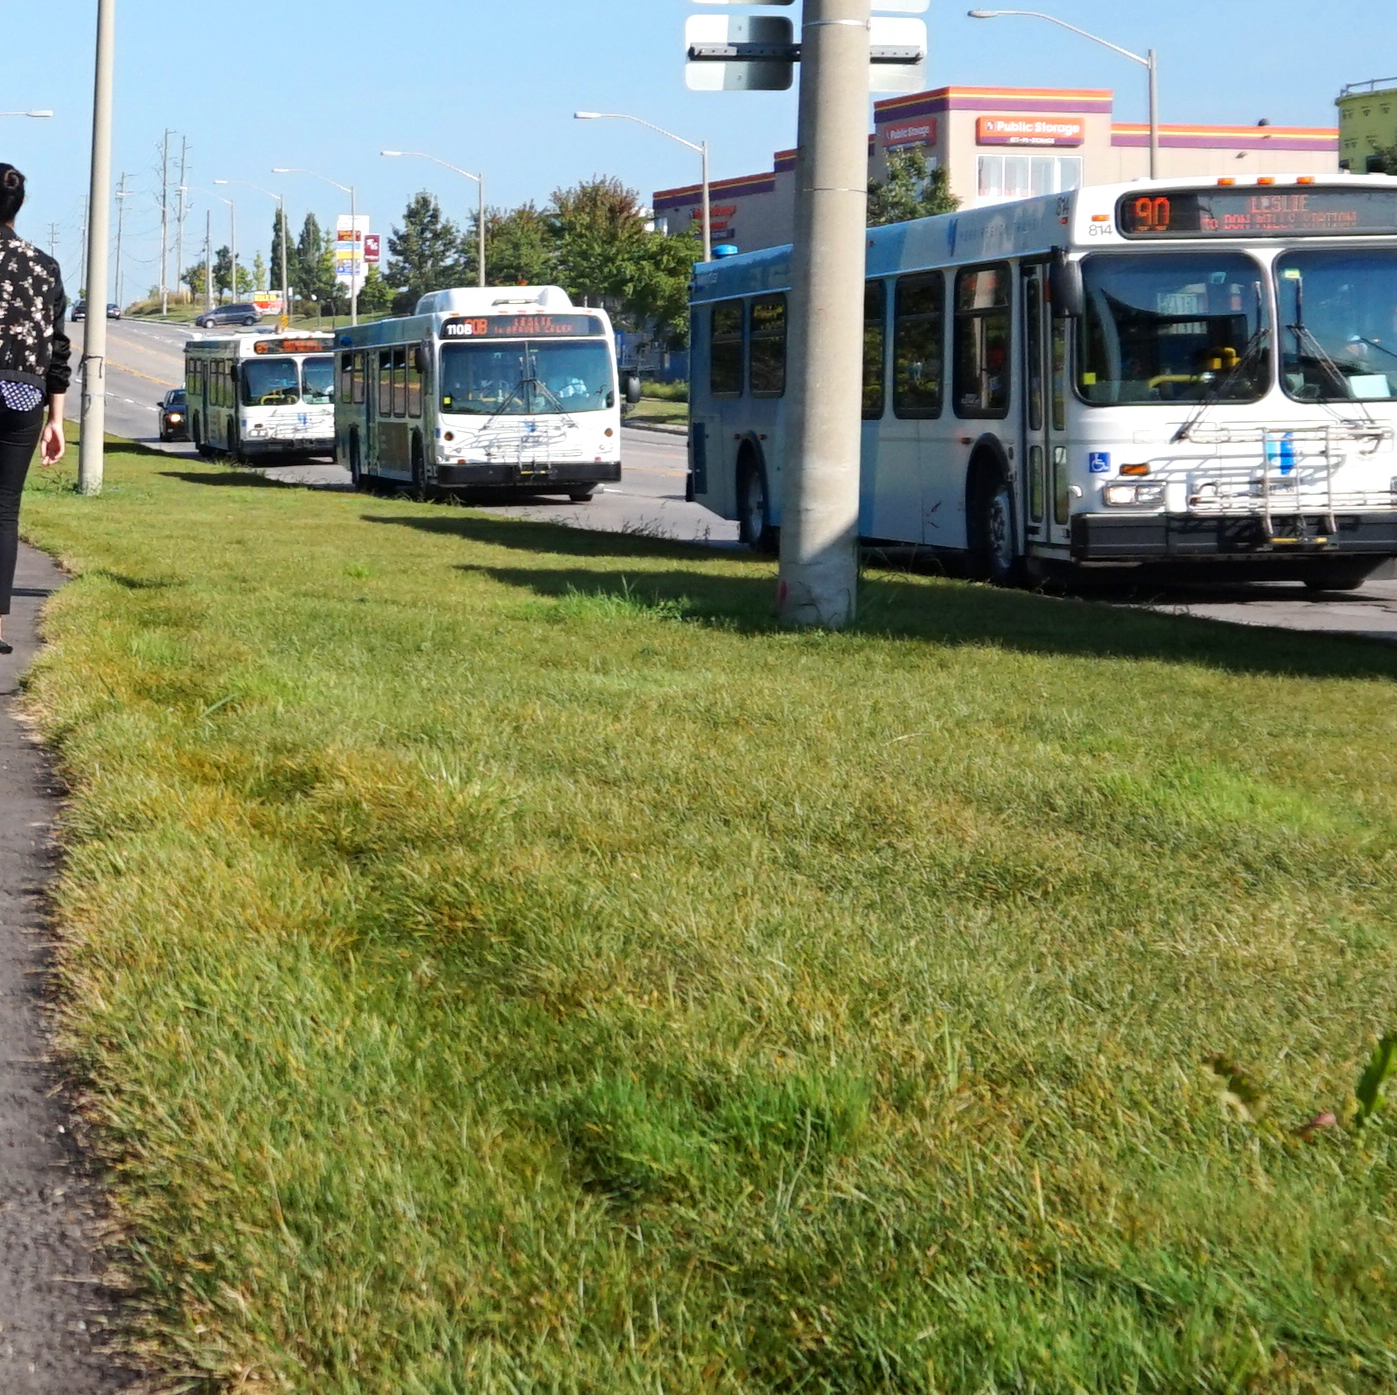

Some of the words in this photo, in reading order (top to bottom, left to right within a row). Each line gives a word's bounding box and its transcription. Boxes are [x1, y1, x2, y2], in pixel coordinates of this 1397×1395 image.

[996, 120, 1033, 132] Public
[1034, 121, 1080, 137] Storage
[1250, 194, 1310, 214] LESLIE
[1135, 197, 1170, 231] 90
[1088, 224, 1113, 236] 814
